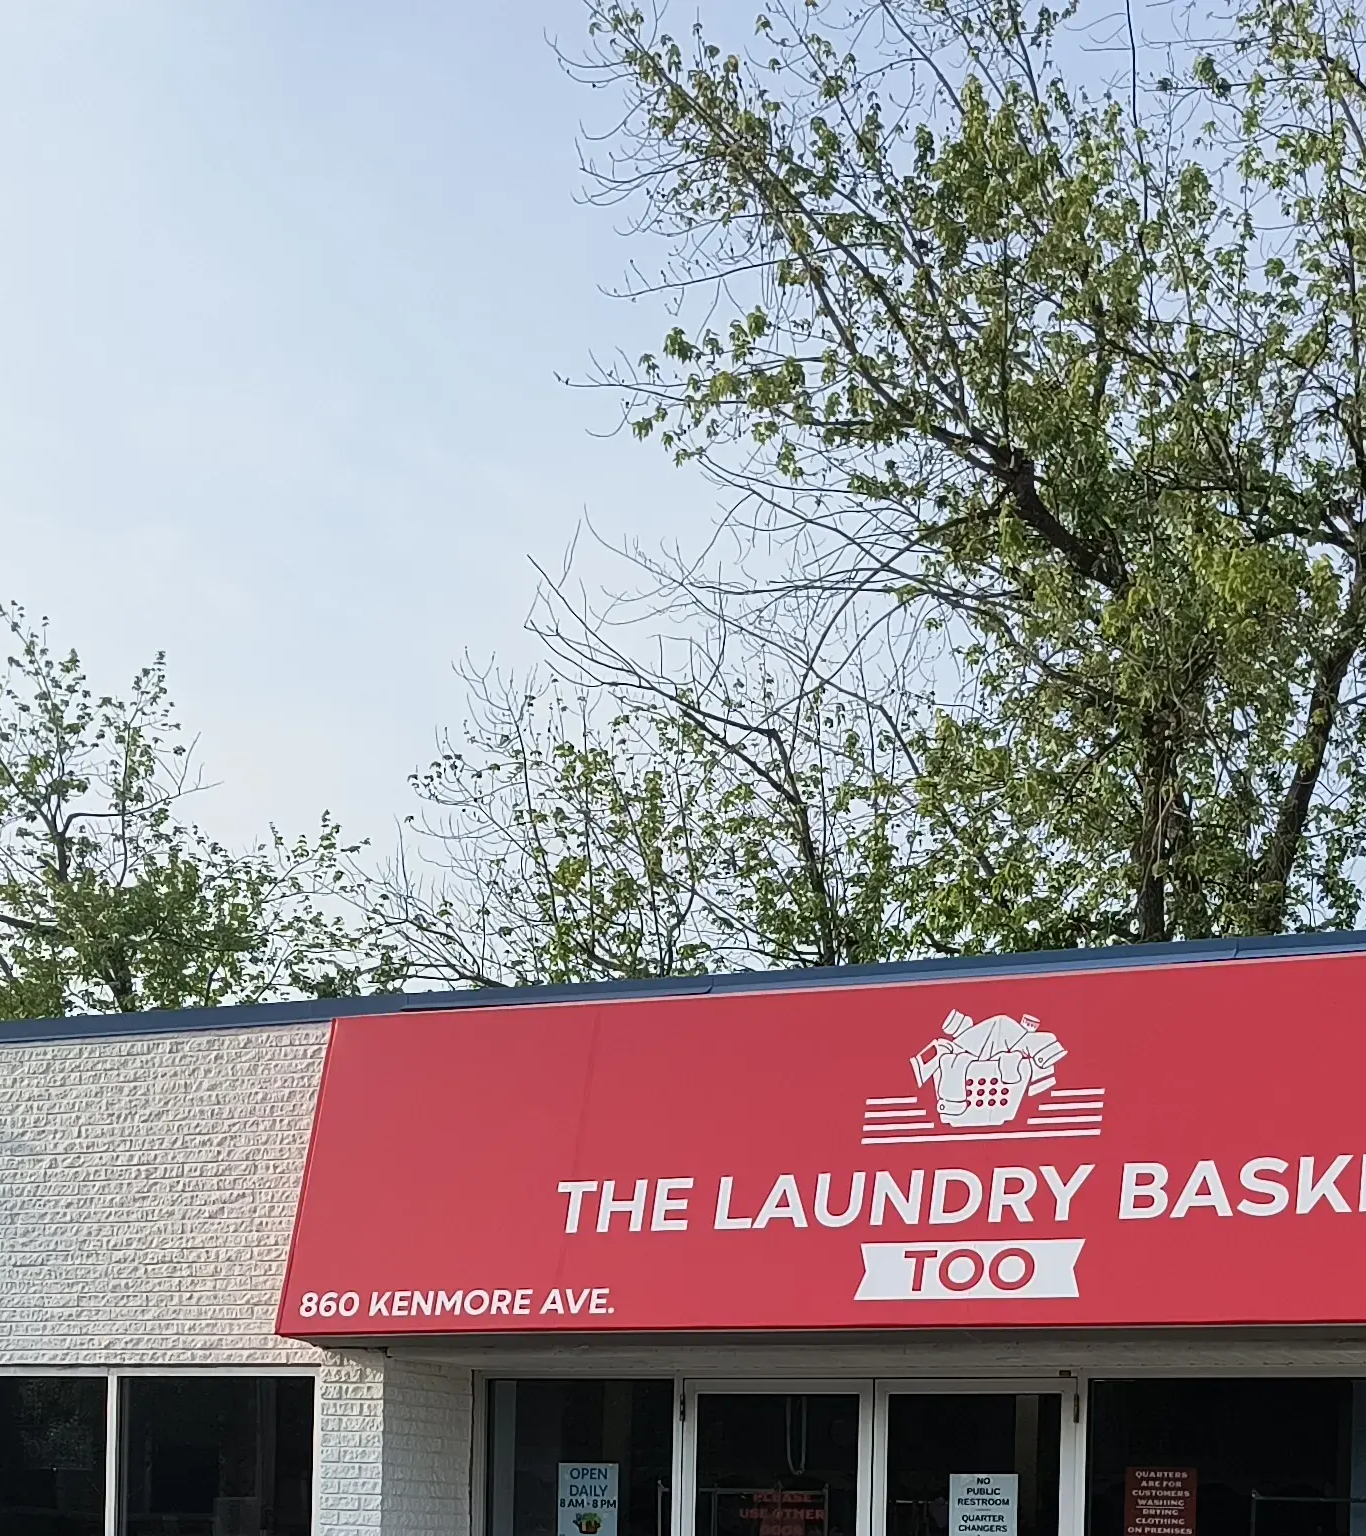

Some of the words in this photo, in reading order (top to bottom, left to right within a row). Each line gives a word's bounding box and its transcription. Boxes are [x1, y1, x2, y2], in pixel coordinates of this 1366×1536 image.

[557, 1177, 694, 1233] THE
[713, 1164, 1095, 1229] LAUNDRY
[903, 1246, 1036, 1293] TOO
[299, 1291, 360, 1318] 860
[367, 1288, 533, 1317] KENMORE
[539, 1287, 616, 1316] AVE.
[569, 1467, 608, 1480] OPEN
[1135, 1470, 1188, 1479] QUARTERS
[976, 1477, 991, 1485] NO
[1140, 1480, 1161, 1488] ARE
[1163, 1480, 1182, 1488] FOR
[569, 1484, 609, 1497] DAILY
[966, 1487, 1001, 1496] PUBLIC
[1132, 1489, 1190, 1497] CUSTOMERS
[560, 1499, 566, 1508] 8
[567, 1499, 585, 1508] AM
[592, 1499, 598, 1508] 8
[600, 1499, 617, 1508] PM
[957, 1498, 1010, 1506] RESTROOM
[1142, 1508, 1179, 1516] DRYING
[961, 1514, 1005, 1523] QUARTER
[1135, 1517, 1185, 1525] CLOTHING
[958, 1524, 1008, 1533] CHANGERS
[1144, 1526, 1193, 1535] PREMISES
